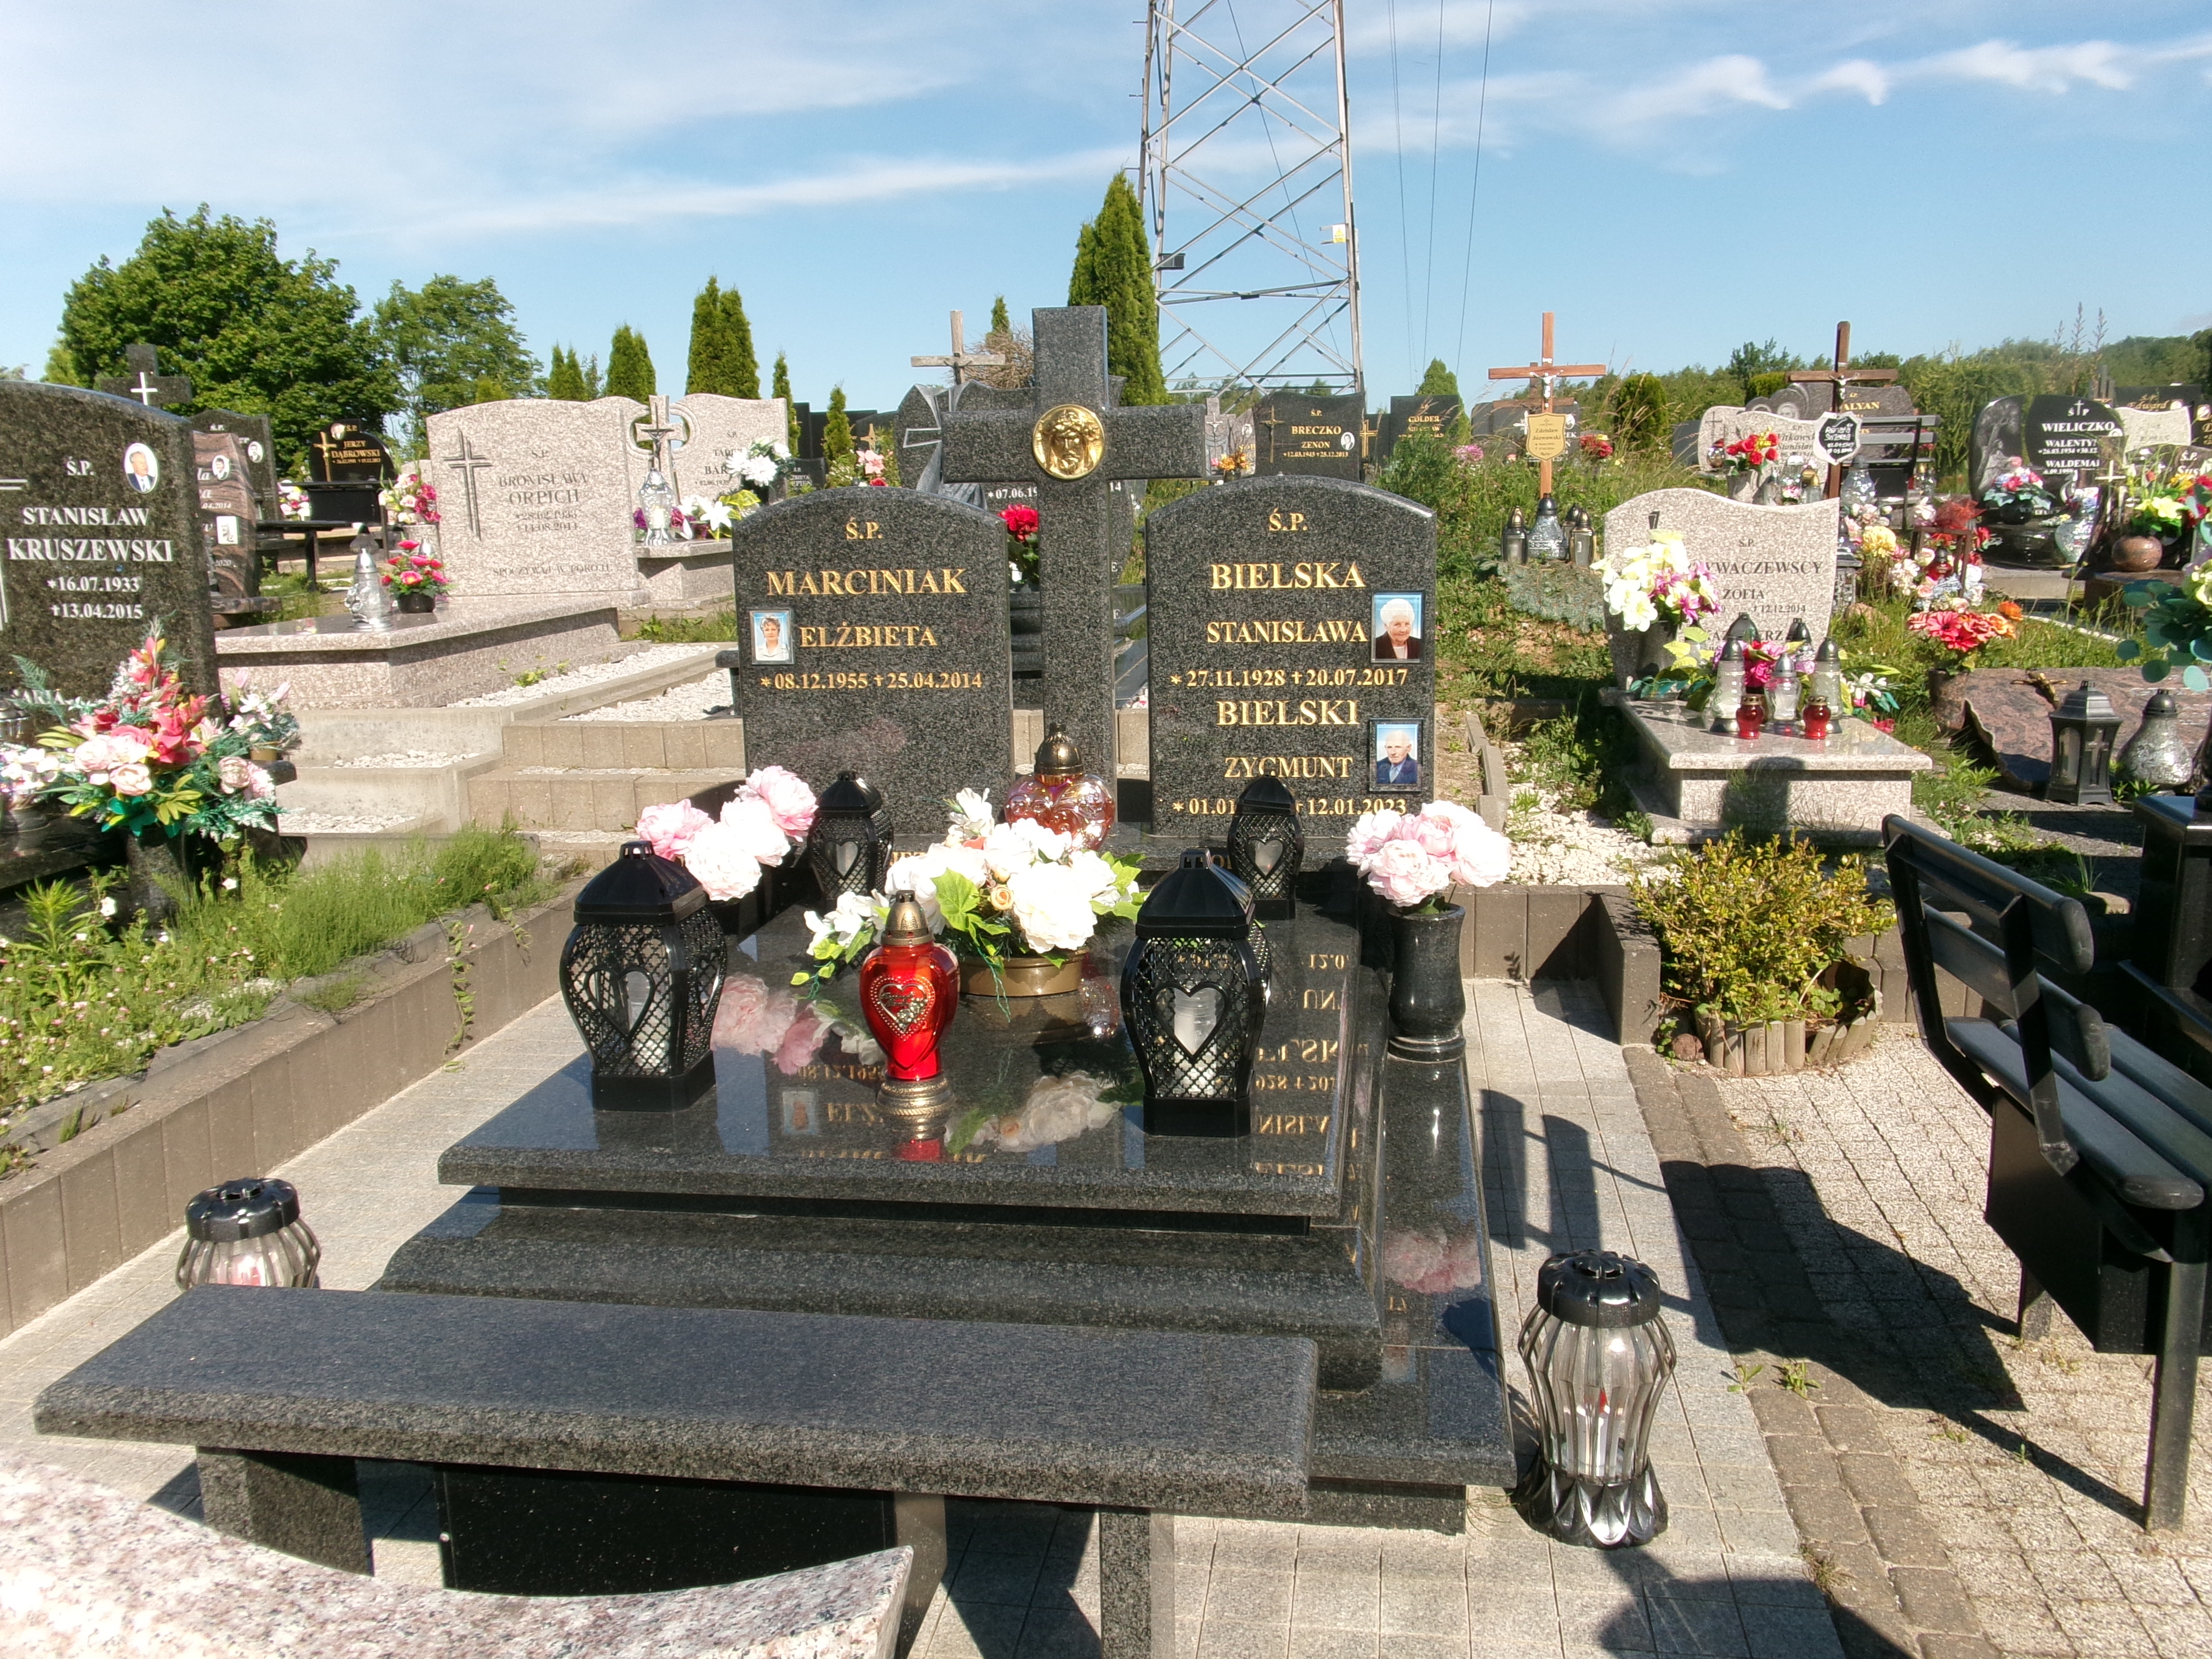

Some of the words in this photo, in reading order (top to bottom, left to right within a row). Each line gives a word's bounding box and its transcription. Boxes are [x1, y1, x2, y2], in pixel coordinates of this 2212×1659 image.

[1844, 402, 1880, 410] ALYAN
[1291, 425, 1342, 435] BRECZKO
[2042, 421, 2115, 432] WIELICZKO
[331, 449, 380, 459] DĄBROWSKI
[344, 440, 366, 449] JERZY
[66, 456, 95, 476] Ś.P.
[509, 489, 579, 505] ORPICH
[996, 486, 1038, 499] 07.06.19
[23, 507, 150, 526] STANISŁAW
[1269, 507, 1308, 531] Ś.P.
[846, 517, 883, 540] Ś.P.
[7, 538, 174, 562] KRUSZEWSKI
[1210, 561, 1367, 589] BIELSKA
[1704, 561, 1823, 575] YWACZEWSCY
[766, 568, 968, 596] MARCINIAK
[1723, 589, 1765, 600] ZOFIA
[799, 621, 938, 648] ELŻBIETA
[1207, 621, 1369, 644] STANISŁAWA
[774, 673, 868, 690] 08.12.1955
[887, 671, 982, 689] 25.04.2014
[1186, 669, 1286, 687] 27.11.1928
[1305, 668, 1408, 686] 20.07.2017
[1216, 699, 1360, 726] BIELSKI
[1224, 756, 1354, 778] ZYGMUNT
[1189, 798, 1237, 815] 01.01
[1307, 798, 1407, 816] 12.01.2023
